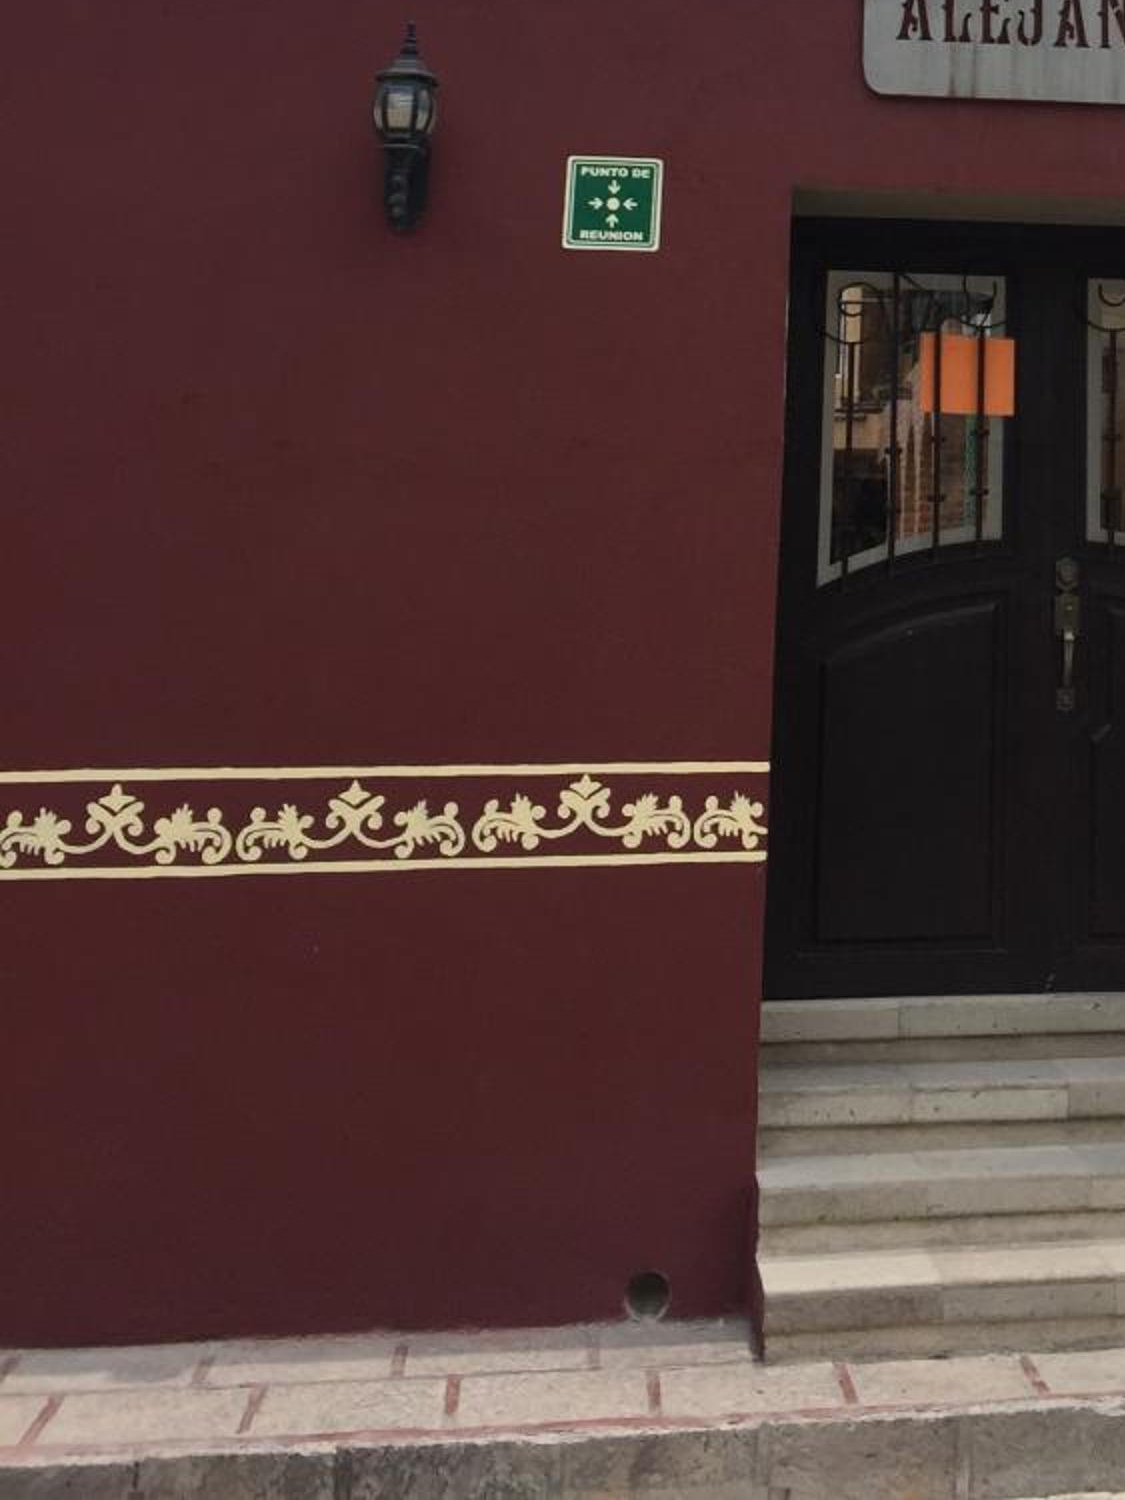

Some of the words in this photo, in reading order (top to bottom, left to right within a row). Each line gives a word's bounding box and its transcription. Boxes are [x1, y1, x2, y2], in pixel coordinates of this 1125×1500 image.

[581, 166, 629, 177] PUNTO
[632, 168, 651, 179] DE
[580, 230, 643, 241] REUNION
